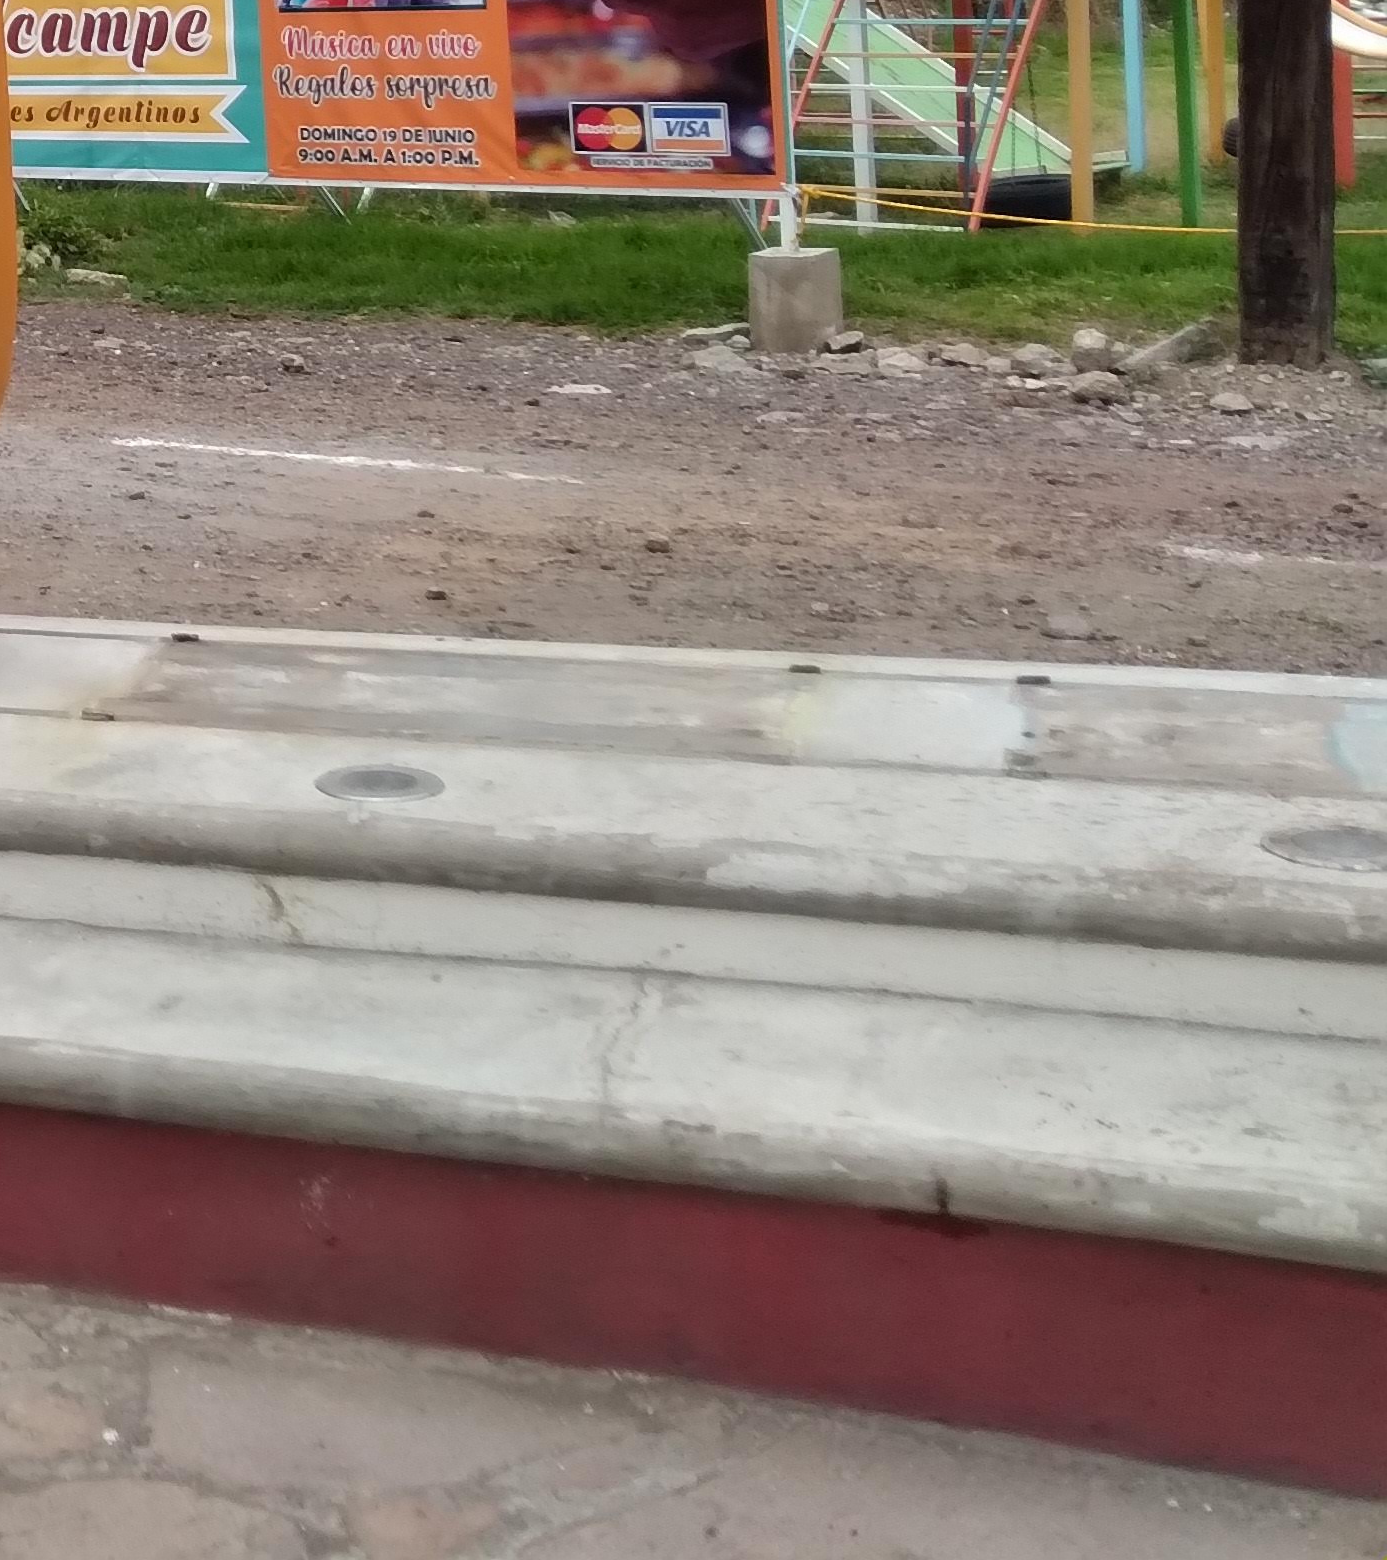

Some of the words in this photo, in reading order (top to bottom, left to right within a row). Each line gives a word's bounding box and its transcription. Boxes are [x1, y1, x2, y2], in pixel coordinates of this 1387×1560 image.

[3, 2, 212, 72] campe
[282, 25, 379, 59] Música
[385, 34, 421, 59] en
[427, 29, 480, 59] vivo
[273, 64, 377, 107] Regalos
[384, 73, 497, 110] sorpresa
[10, 105, 34, 122] es
[45, 100, 200, 129] Argentinos
[664, 120, 711, 137] VISA
[299, 127, 377, 142] DOMINGO
[381, 129, 397, 142] 19
[402, 128, 425, 143] DE
[427, 128, 475, 144] JUNIO
[297, 147, 335, 163] 9:00
[340, 148, 378, 164] A.M.
[383, 149, 396, 164] A
[400, 150, 436, 165] 1:00
[440, 150, 479, 166] P.M.
